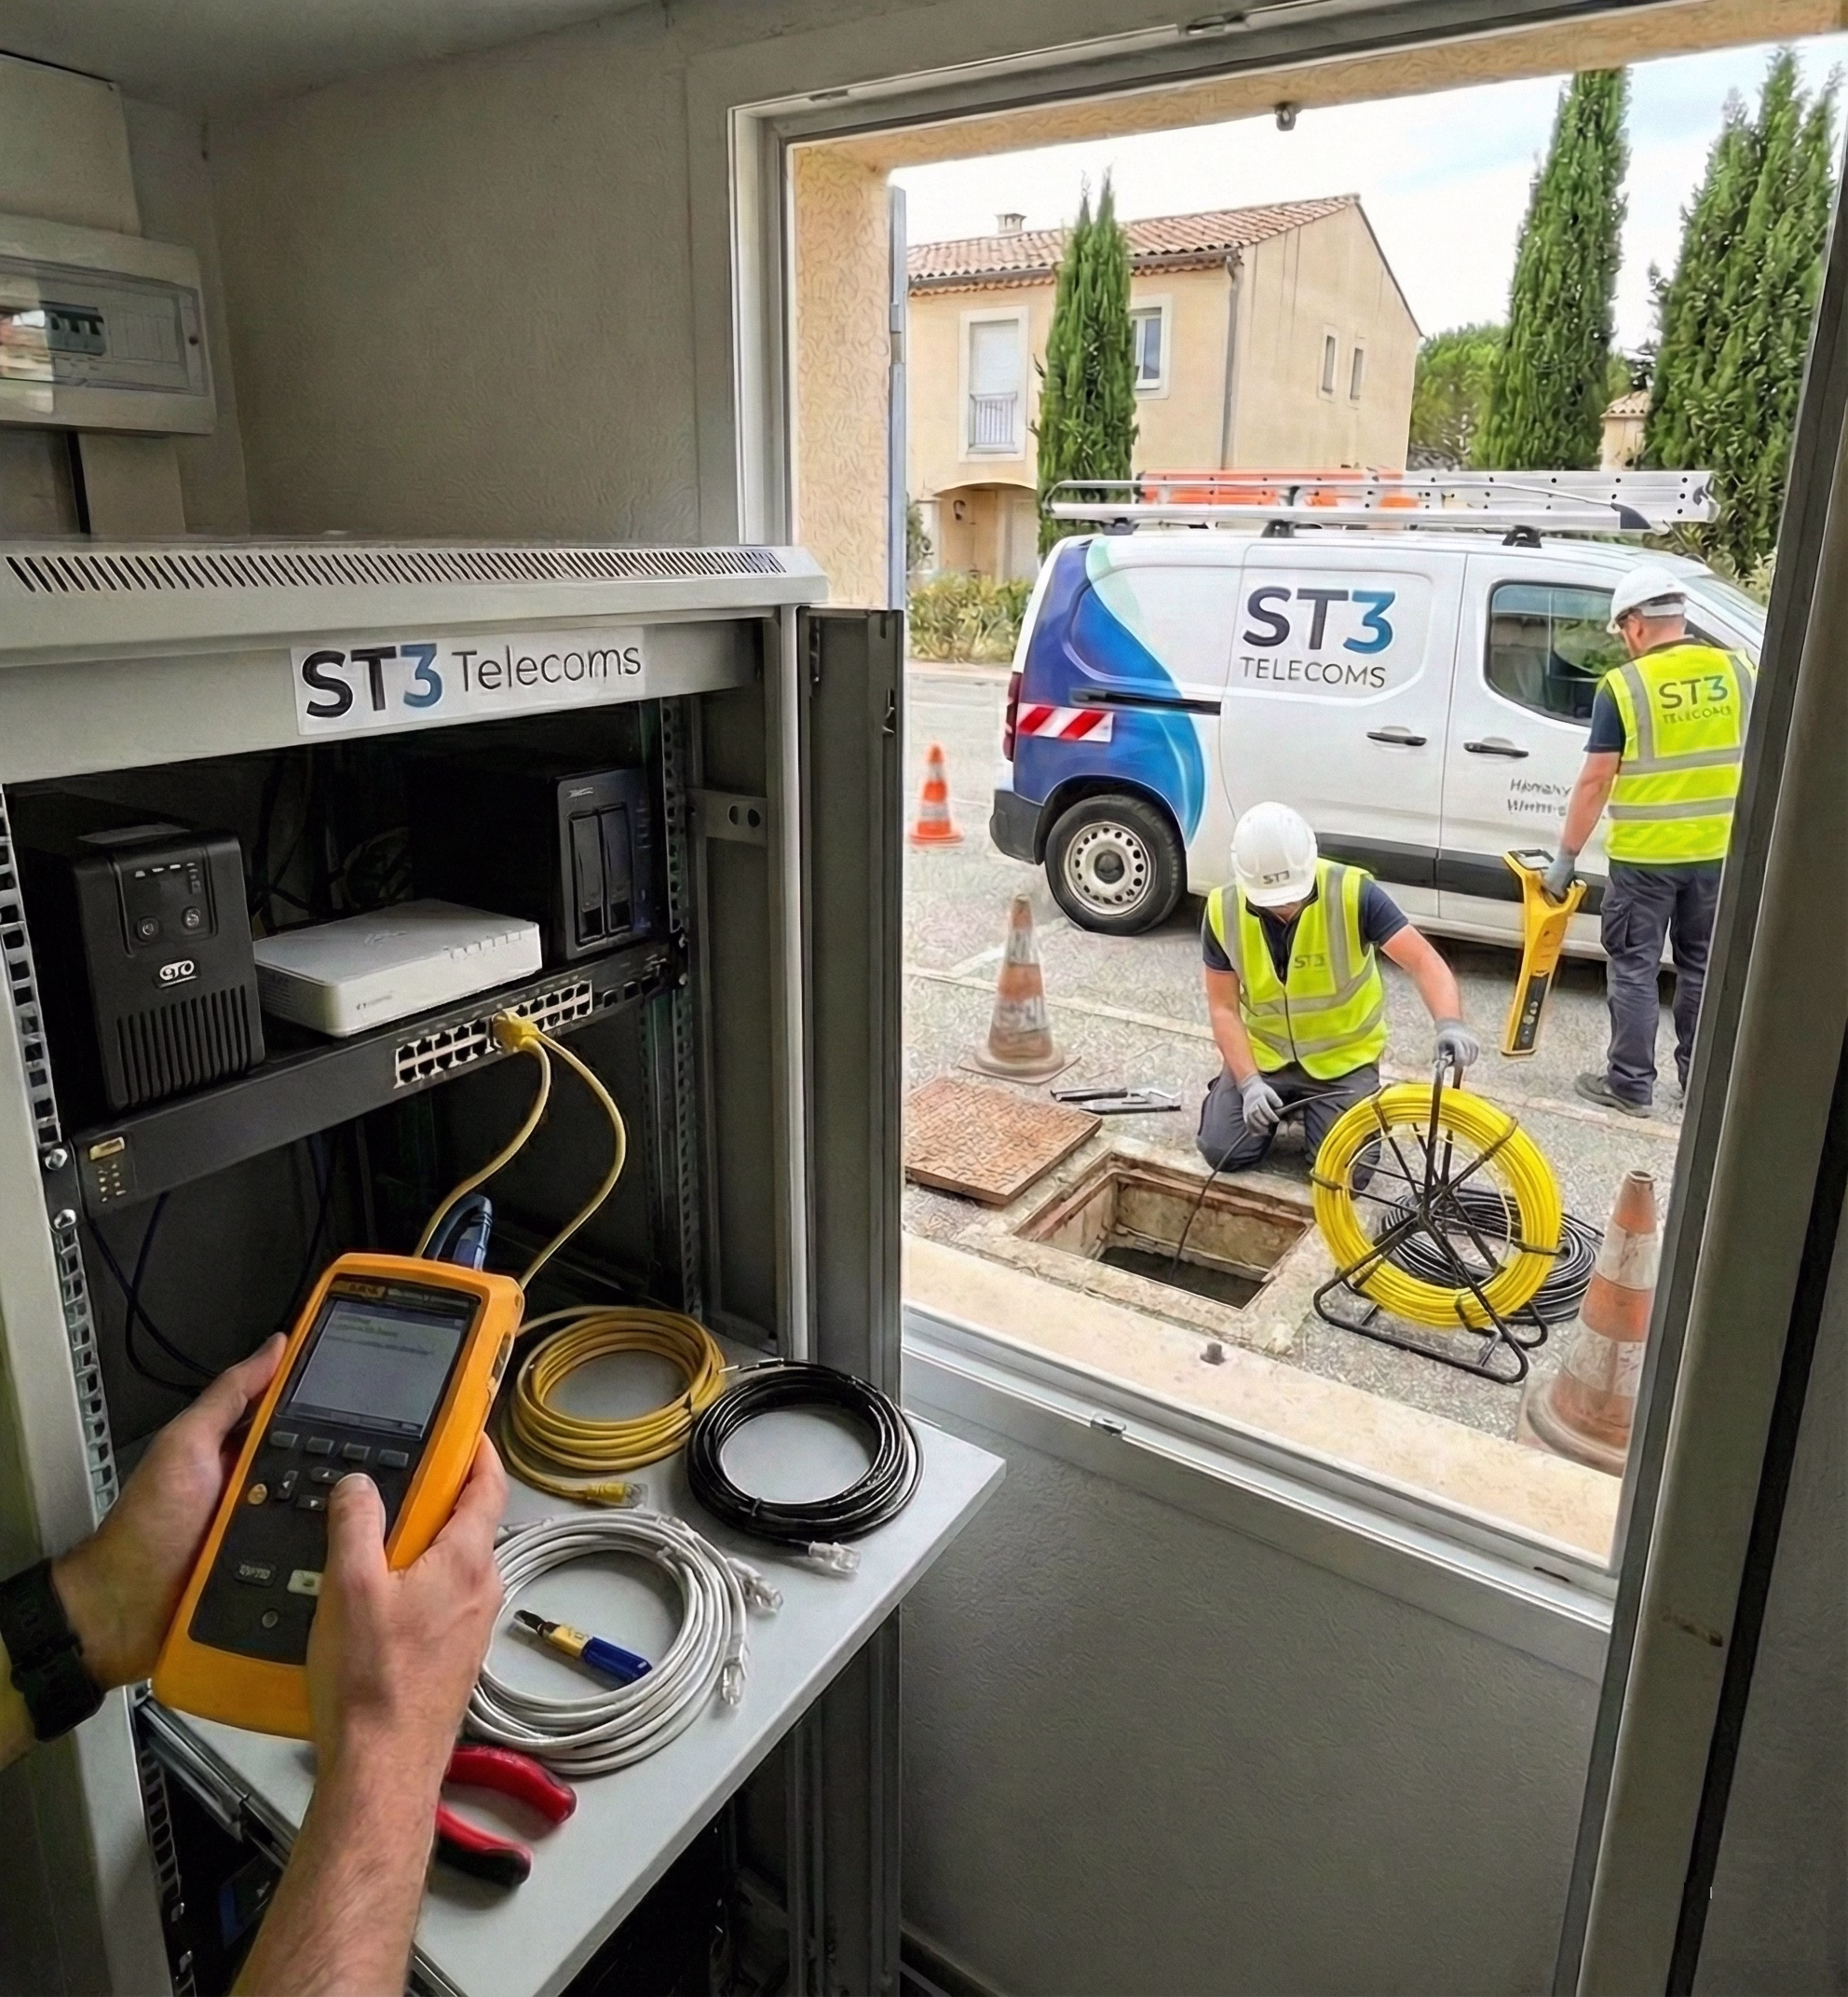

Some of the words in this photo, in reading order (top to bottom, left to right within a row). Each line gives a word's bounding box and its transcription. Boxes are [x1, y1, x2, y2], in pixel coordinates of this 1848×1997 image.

[1243, 586, 1396, 655] ST3
[301, 643, 443, 719] ST3
[452, 645, 642, 692] Telecoms
[1240, 656, 1387, 689] TELECOMS
[1658, 674, 1729, 710] ST3
